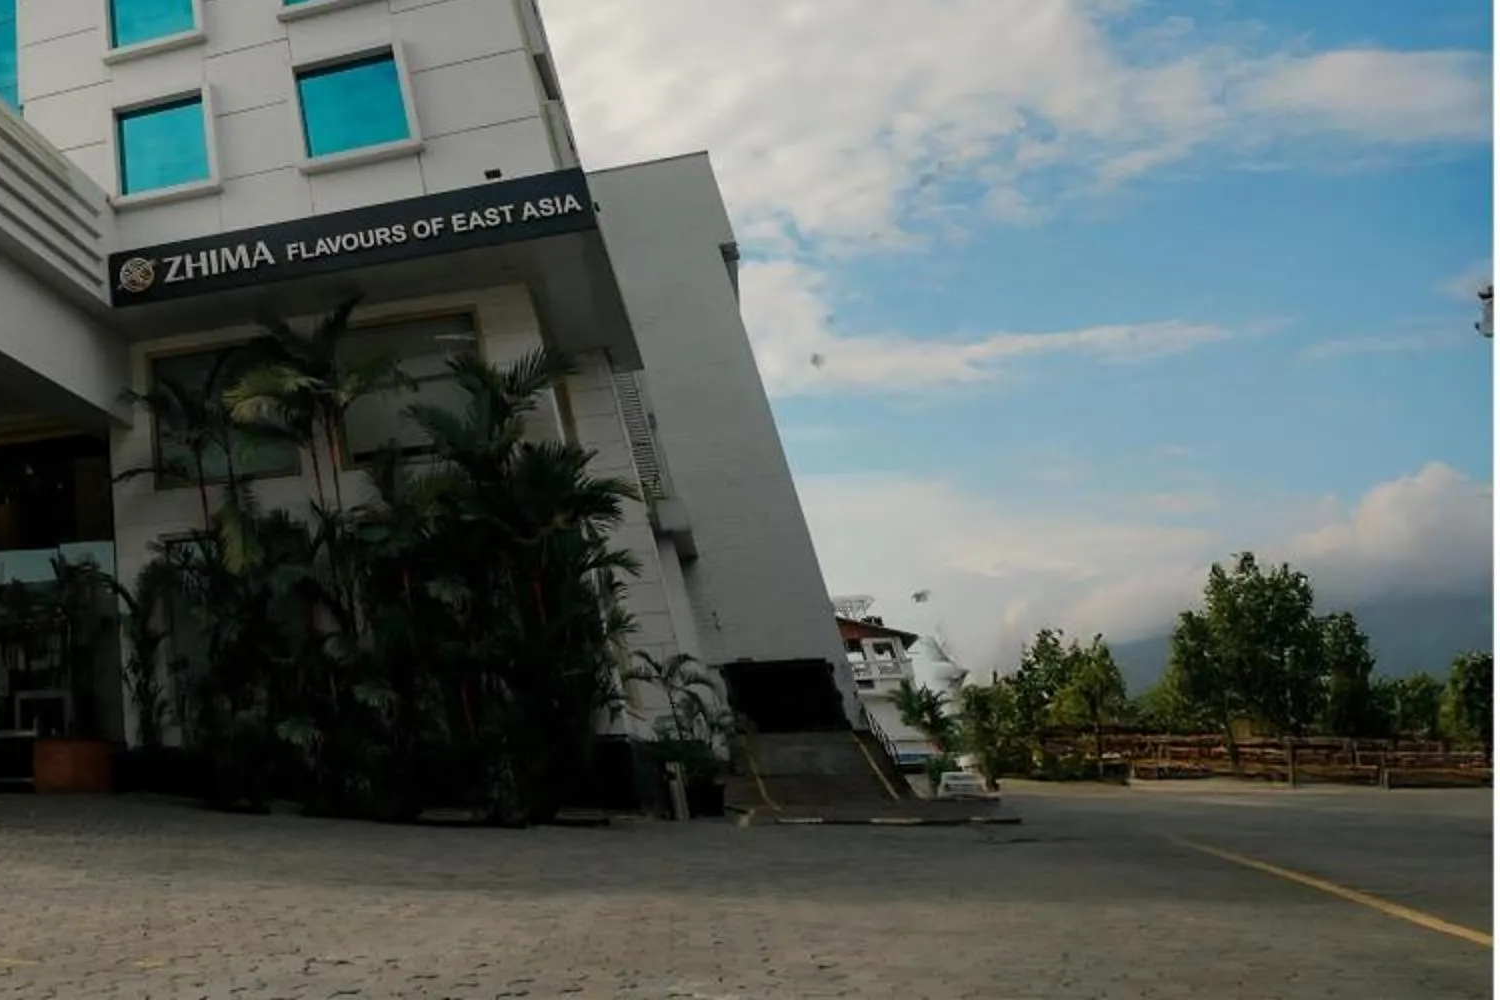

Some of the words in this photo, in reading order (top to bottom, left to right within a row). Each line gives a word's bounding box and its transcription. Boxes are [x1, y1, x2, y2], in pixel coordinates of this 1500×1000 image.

[162, 240, 276, 284] ZHIMA
[286, 224, 408, 262] FLAVOURS
[412, 217, 445, 239] OF
[451, 204, 515, 233] EAST
[521, 193, 582, 221] ASIA
